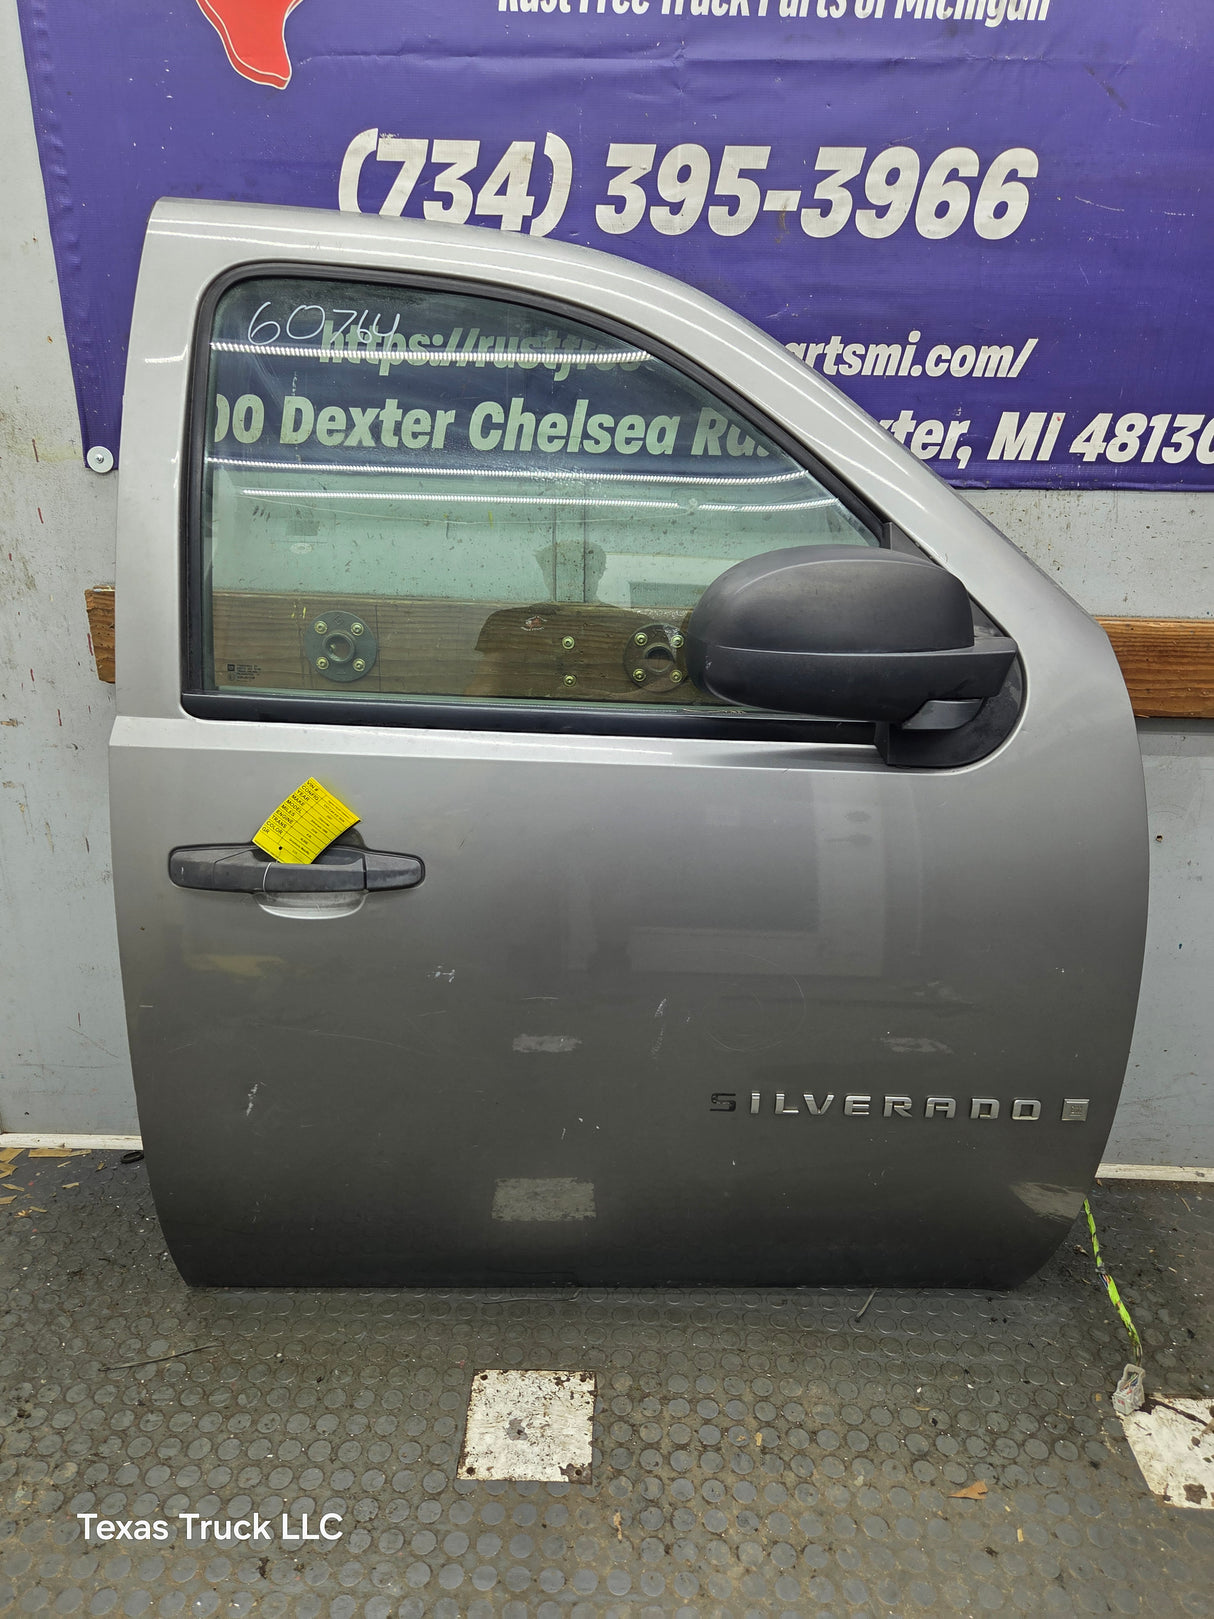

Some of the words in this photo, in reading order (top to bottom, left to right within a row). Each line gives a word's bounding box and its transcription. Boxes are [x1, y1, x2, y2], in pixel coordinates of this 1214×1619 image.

[338, 128, 573, 237] (734)
[595, 143, 1039, 240] 395-3966
[248, 301, 400, 352] 60764
[279, 395, 456, 449] Dexter
[468, 396, 681, 456] Chelsea
[879, 410, 972, 470] ter,
[986, 411, 1066, 461] MI
[287, 800, 302, 813] MODEL
[296, 790, 310, 801] YEAR
[266, 821, 283, 834] COLOR
[709, 1091, 1042, 1120] SILVERADO
